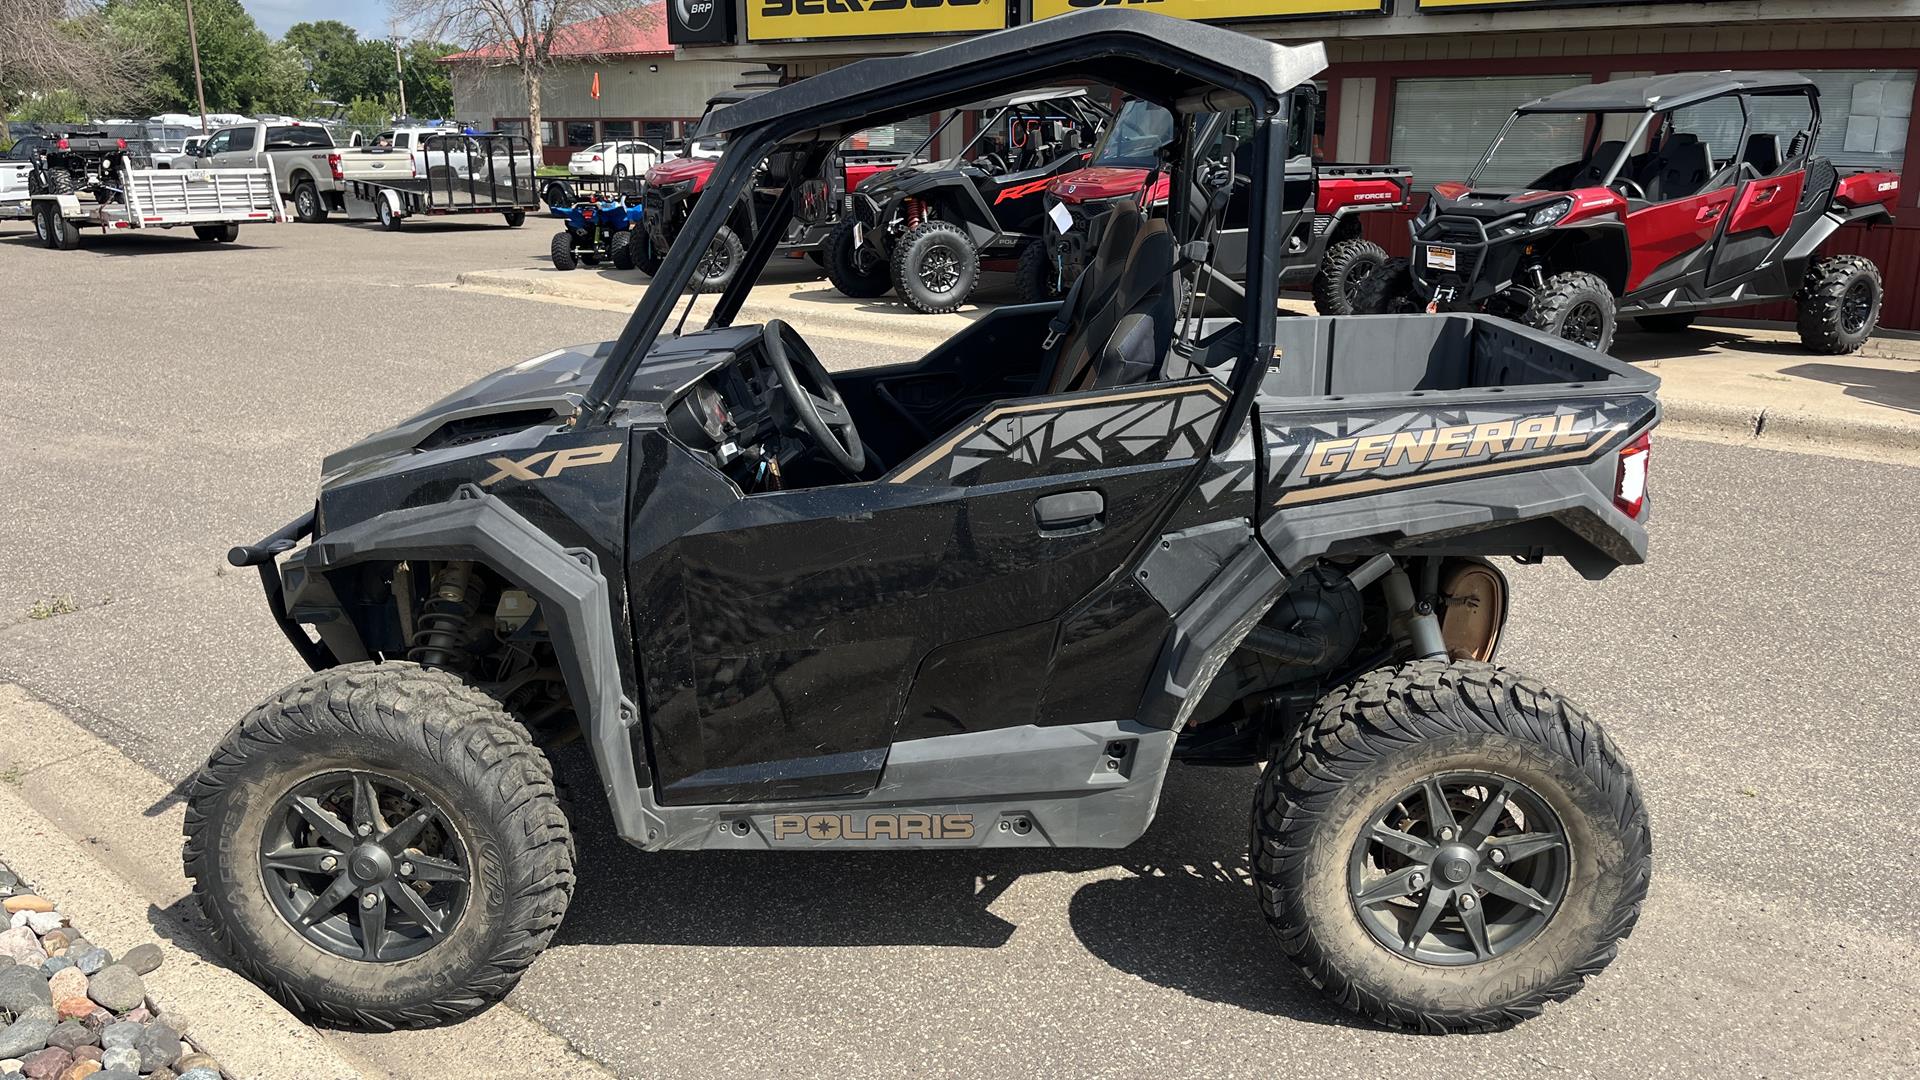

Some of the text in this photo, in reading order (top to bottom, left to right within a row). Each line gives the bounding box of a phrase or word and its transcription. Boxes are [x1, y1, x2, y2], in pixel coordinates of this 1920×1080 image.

[691, 3, 712, 14] BRP
[1300, 414, 1592, 478] GENERAL
[480, 443, 622, 486] XP
[774, 814, 975, 840] POLARIS
